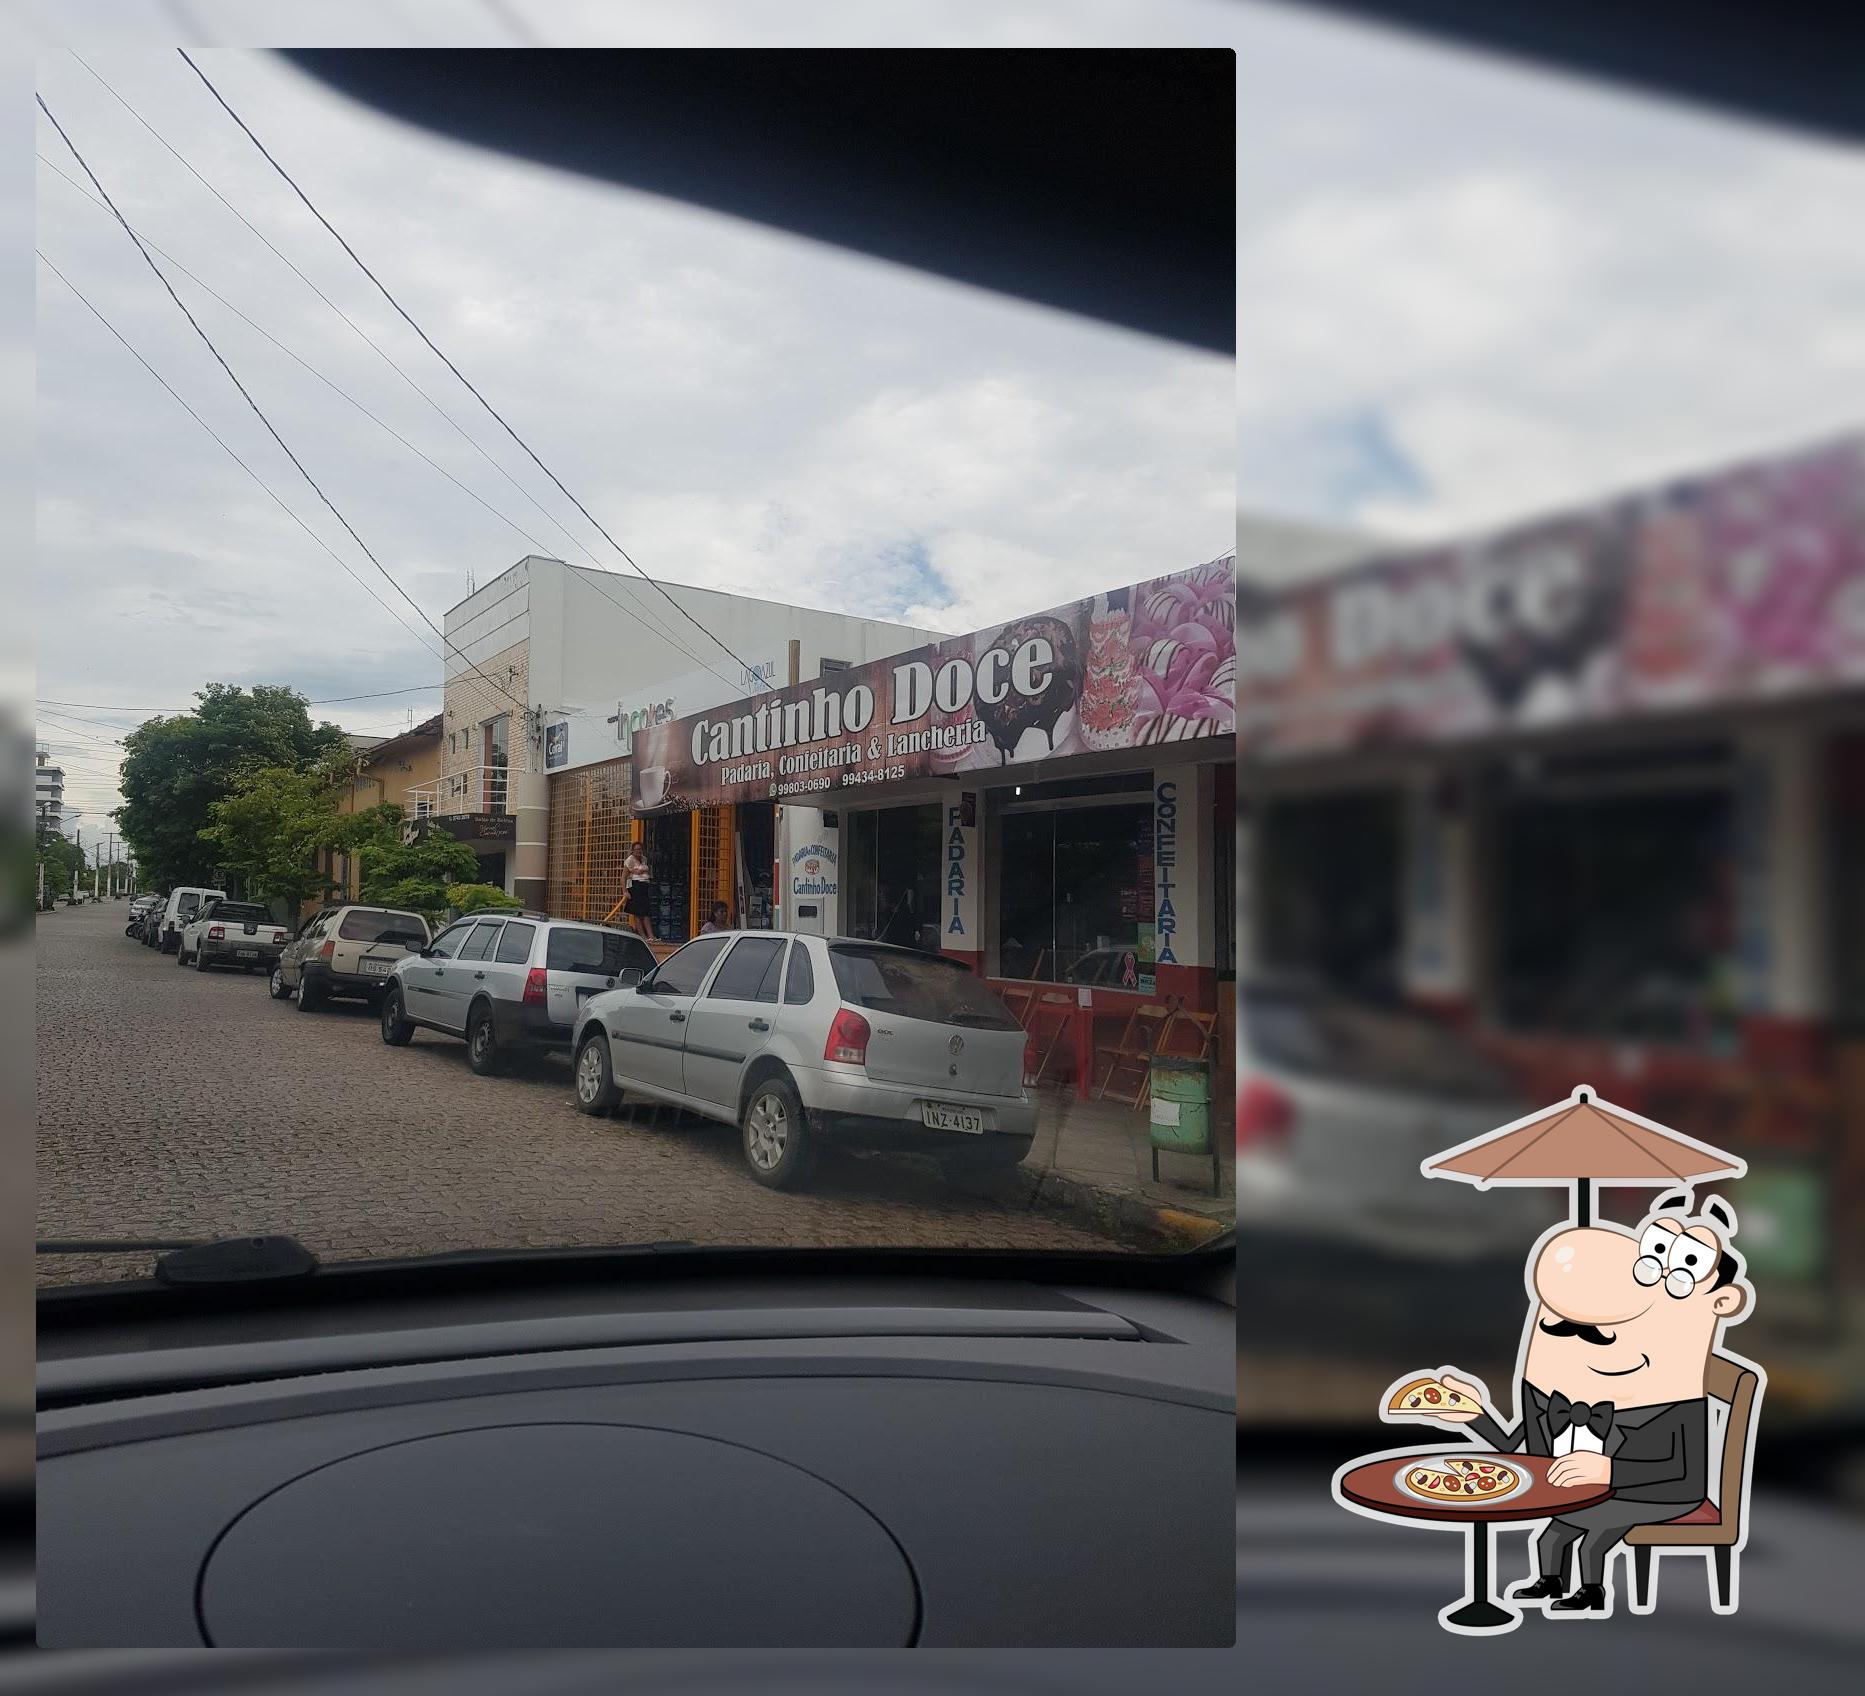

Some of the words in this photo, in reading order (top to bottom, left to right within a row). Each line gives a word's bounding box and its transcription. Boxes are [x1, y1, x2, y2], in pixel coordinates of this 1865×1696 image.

[691, 684, 874, 766] Cantinho
[891, 637, 1054, 725] Doce
[721, 764, 774, 786] Padaria,
[779, 743, 862, 776] Confeitaria
[867, 737, 881, 760] &
[887, 719, 986, 758] Lancheria
[778, 777, 831, 795] 99803-0690
[842, 765, 905, 786] 99434-8125
[793, 876, 820, 895] Cantinho
[821, 876, 837, 895] Doce
[1157, 782, 1178, 963] CONFEITARIA
